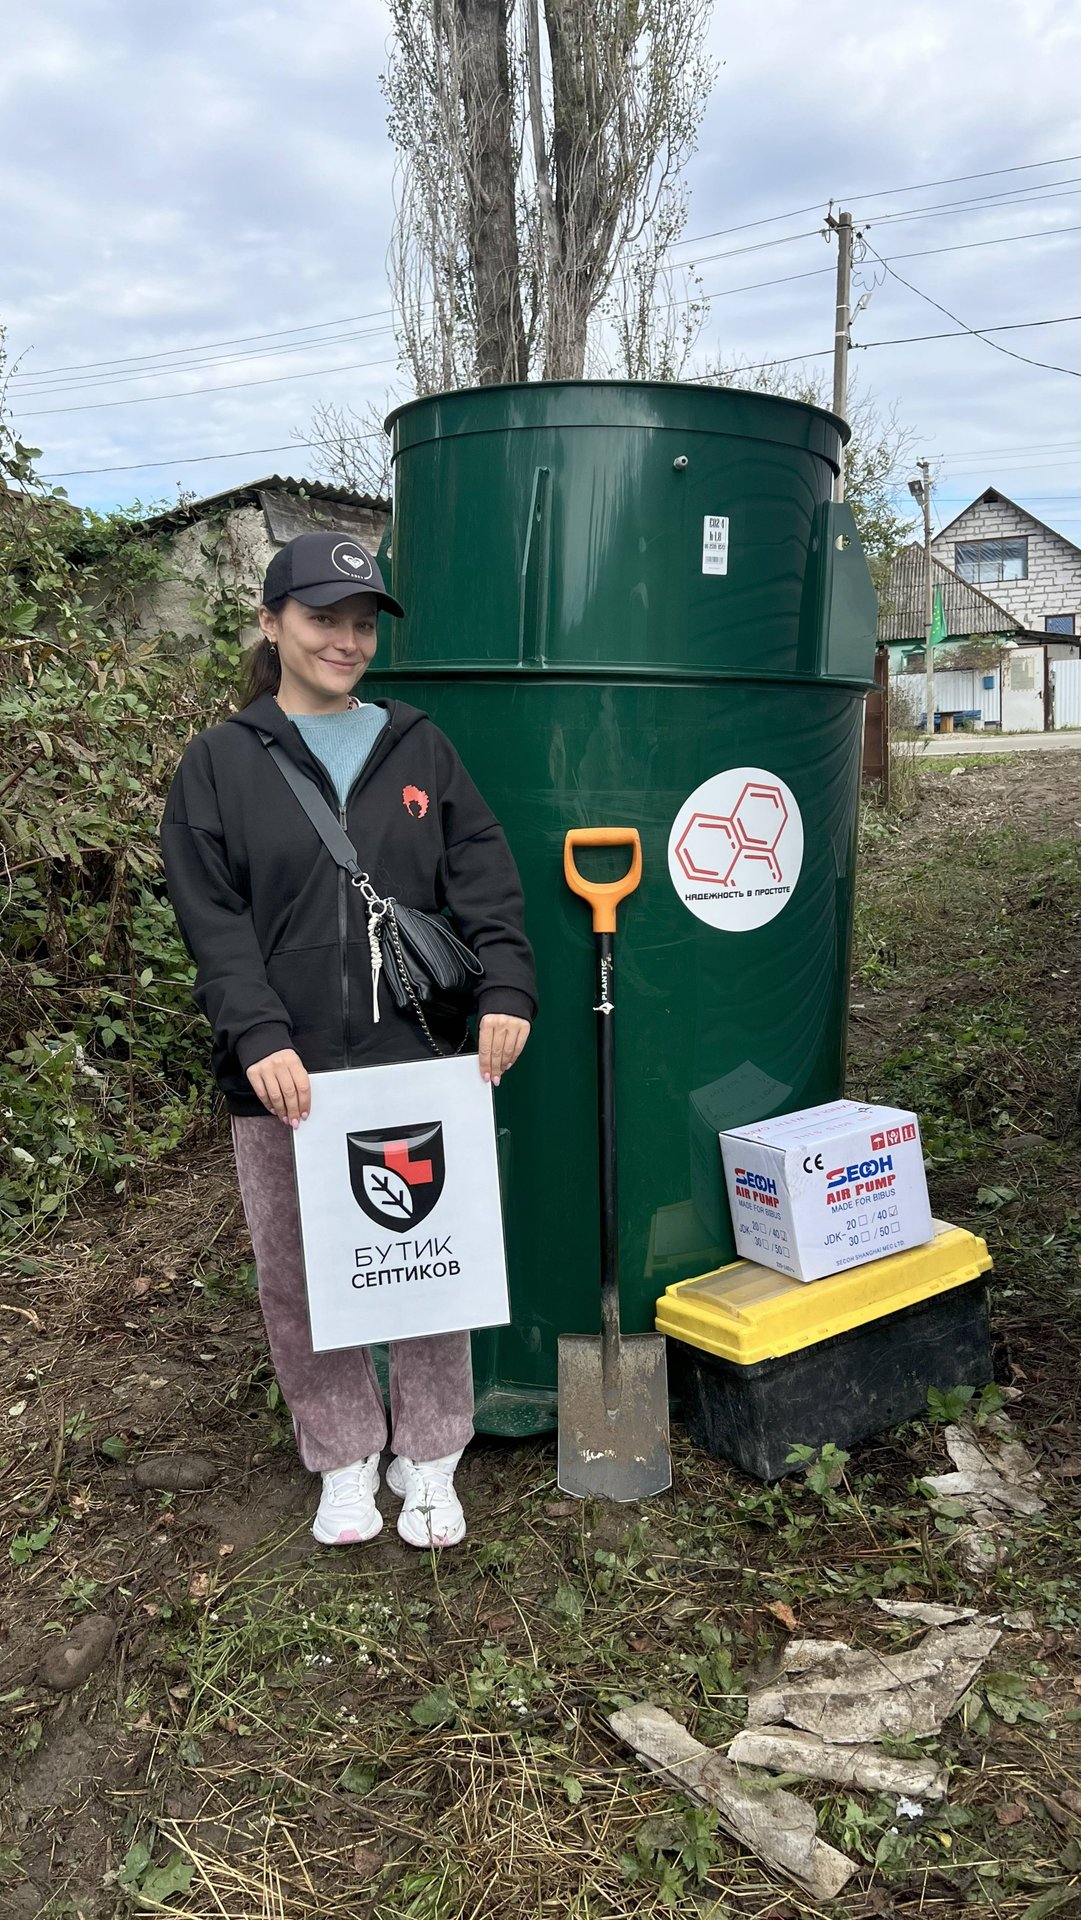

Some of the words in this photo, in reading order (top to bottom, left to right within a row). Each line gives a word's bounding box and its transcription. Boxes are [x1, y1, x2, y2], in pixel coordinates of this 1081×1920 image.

[685, 890, 744, 901] НАДЕЖНОСТЬ
[755, 886, 790, 896] ПРОСТОТЕ
[826, 1154, 893, 1189] SECOH
[735, 1184, 751, 1200] AIR
[752, 1190, 779, 1208] PUMP
[826, 1188, 851, 1205] AIR
[855, 1174, 896, 1196] PUMP
[831, 1201, 853, 1214] MADE
[855, 1195, 871, 1206] FOR
[872, 1188, 896, 1202] BIBUS
[738, 1199, 753, 1211] MADE
[753, 1204, 765, 1214] FOR
[846, 1218, 857, 1231] 20
[354, 1235, 453, 1268] БУТИК
[848, 1235, 859, 1247] 30
[351, 1260, 461, 1289] СЕПТИКОВ
